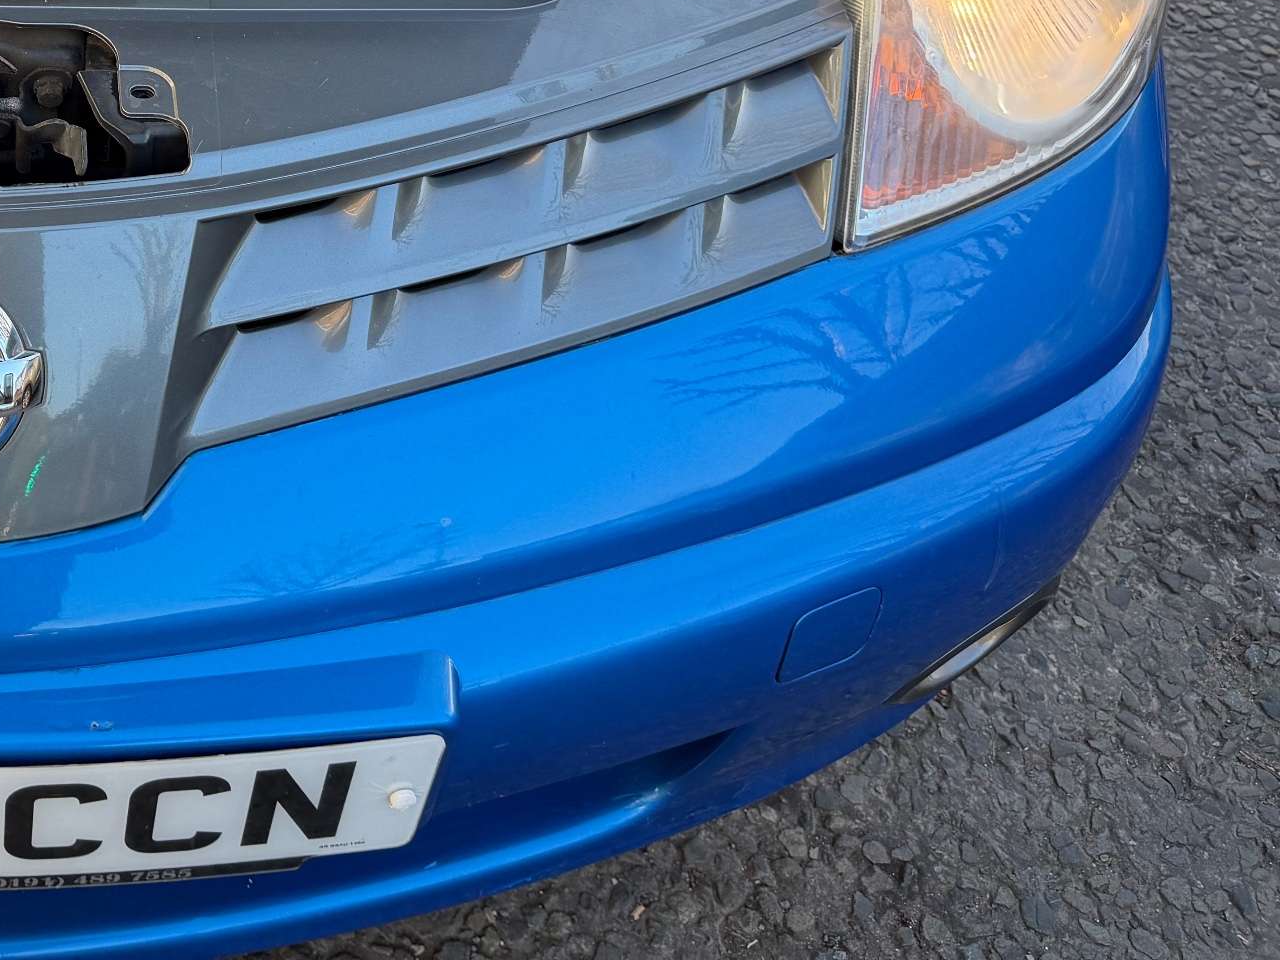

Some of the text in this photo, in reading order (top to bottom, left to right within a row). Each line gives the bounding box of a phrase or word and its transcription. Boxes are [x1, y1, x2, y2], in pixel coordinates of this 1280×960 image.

[4, 760, 358, 860] CCN
[73, 872, 121, 886] 489
[129, 867, 193, 882] 7585
